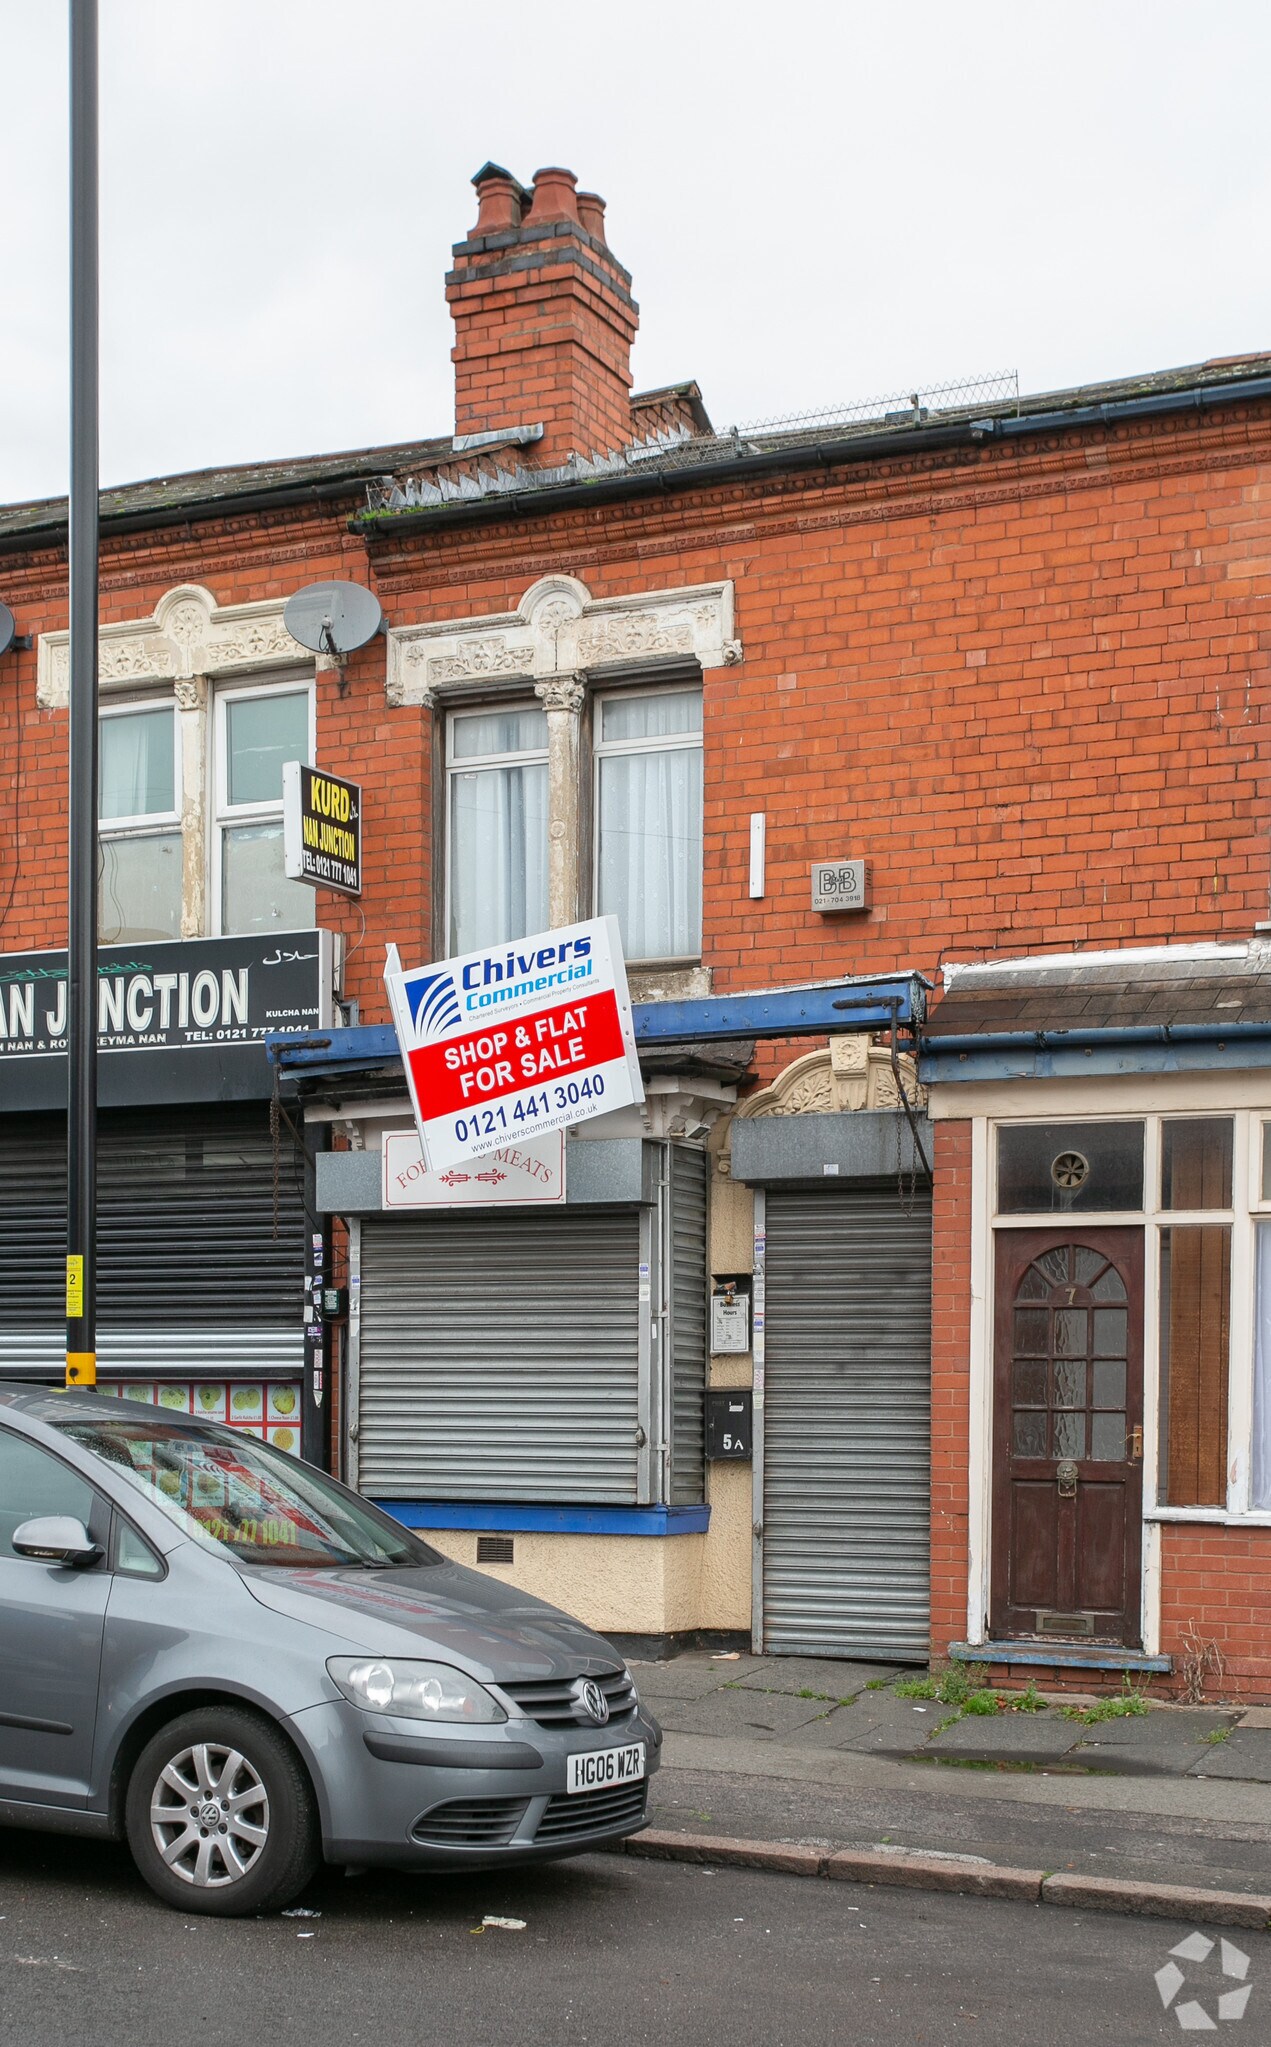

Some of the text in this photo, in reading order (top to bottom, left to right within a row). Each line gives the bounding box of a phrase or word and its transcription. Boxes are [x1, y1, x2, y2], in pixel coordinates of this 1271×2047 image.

[311, 775, 350, 822] KURD
[303, 815, 355, 861] NAN JUNCTION
[302, 849, 357, 886] TEL: 0121 777 1041
[462, 936, 592, 991] Chivers
[466, 959, 592, 1011] Commercial
[46, 968, 248, 1036] JNCTION
[266, 1007, 319, 1018] KULCHA NAN
[468, 978, 600, 1022] Chartered Surveyors Commercial Property Consultants
[7, 1039, 34, 1051] NAN
[37, 1039, 46, 1050] &
[138, 1033, 167, 1044] NAN
[184, 1031, 213, 1042] TEL:
[216, 1028, 247, 1040] 0121
[444, 1006, 588, 1070] SHOP & FLAT
[459, 1036, 587, 1098] FOR SALE
[455, 1073, 605, 1142] 0121 441 3040
[471, 1103, 598, 1153] www.chiverscommercial.co.uk
[493, 1148, 553, 1183] MEATS
[69, 1273, 76, 1285] 2
[1064, 1287, 1076, 1306] 7
[261, 1519, 296, 1545] 1041
[575, 1747, 640, 1787] HG06 WZR
